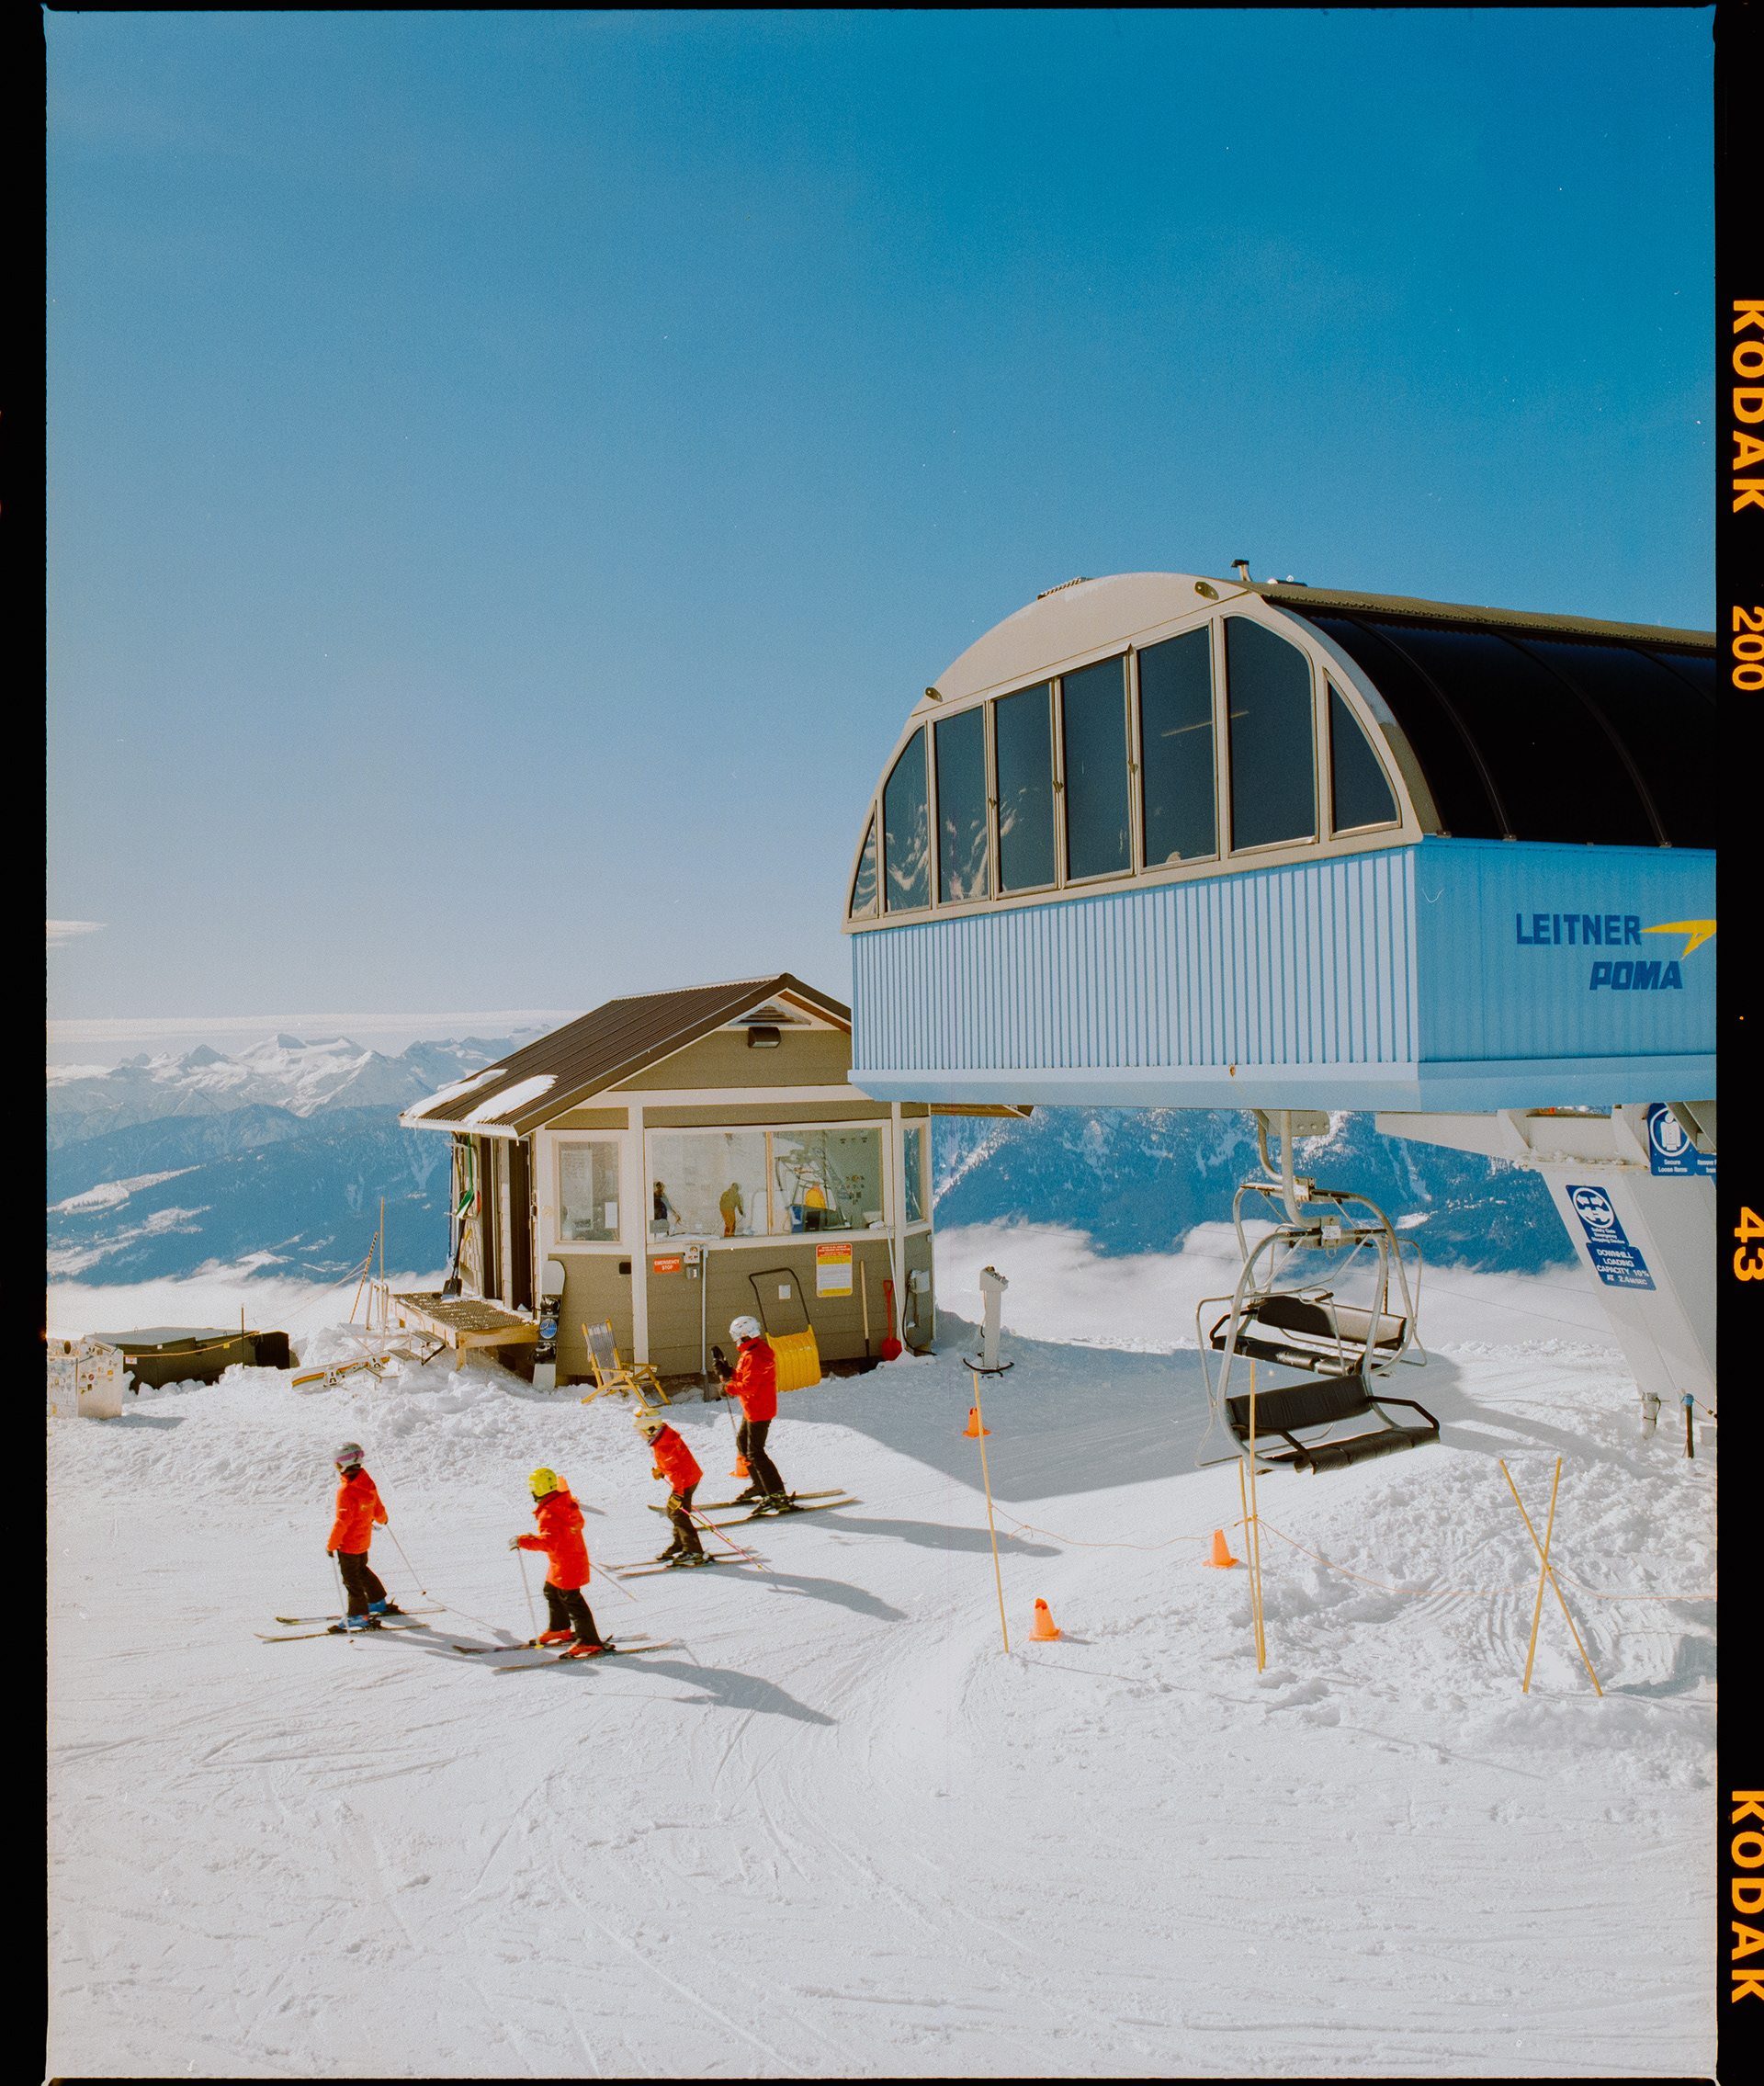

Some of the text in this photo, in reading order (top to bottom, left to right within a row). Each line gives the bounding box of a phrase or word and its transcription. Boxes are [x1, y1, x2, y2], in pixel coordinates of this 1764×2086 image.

[1732, 299, 1764, 514] KODAK
[1732, 605, 1764, 691] 200
[1516, 913, 1642, 946] LEITNER
[1589, 960, 1683, 990] POMA
[1596, 1249, 1634, 1259] DOWNHILL
[1734, 1206, 1764, 1282] 43
[1596, 1264, 1650, 1277] CAPACITY 10%
[1602, 1257, 1634, 1267] LOADING
[1731, 1790, 1764, 2004] KODAK
